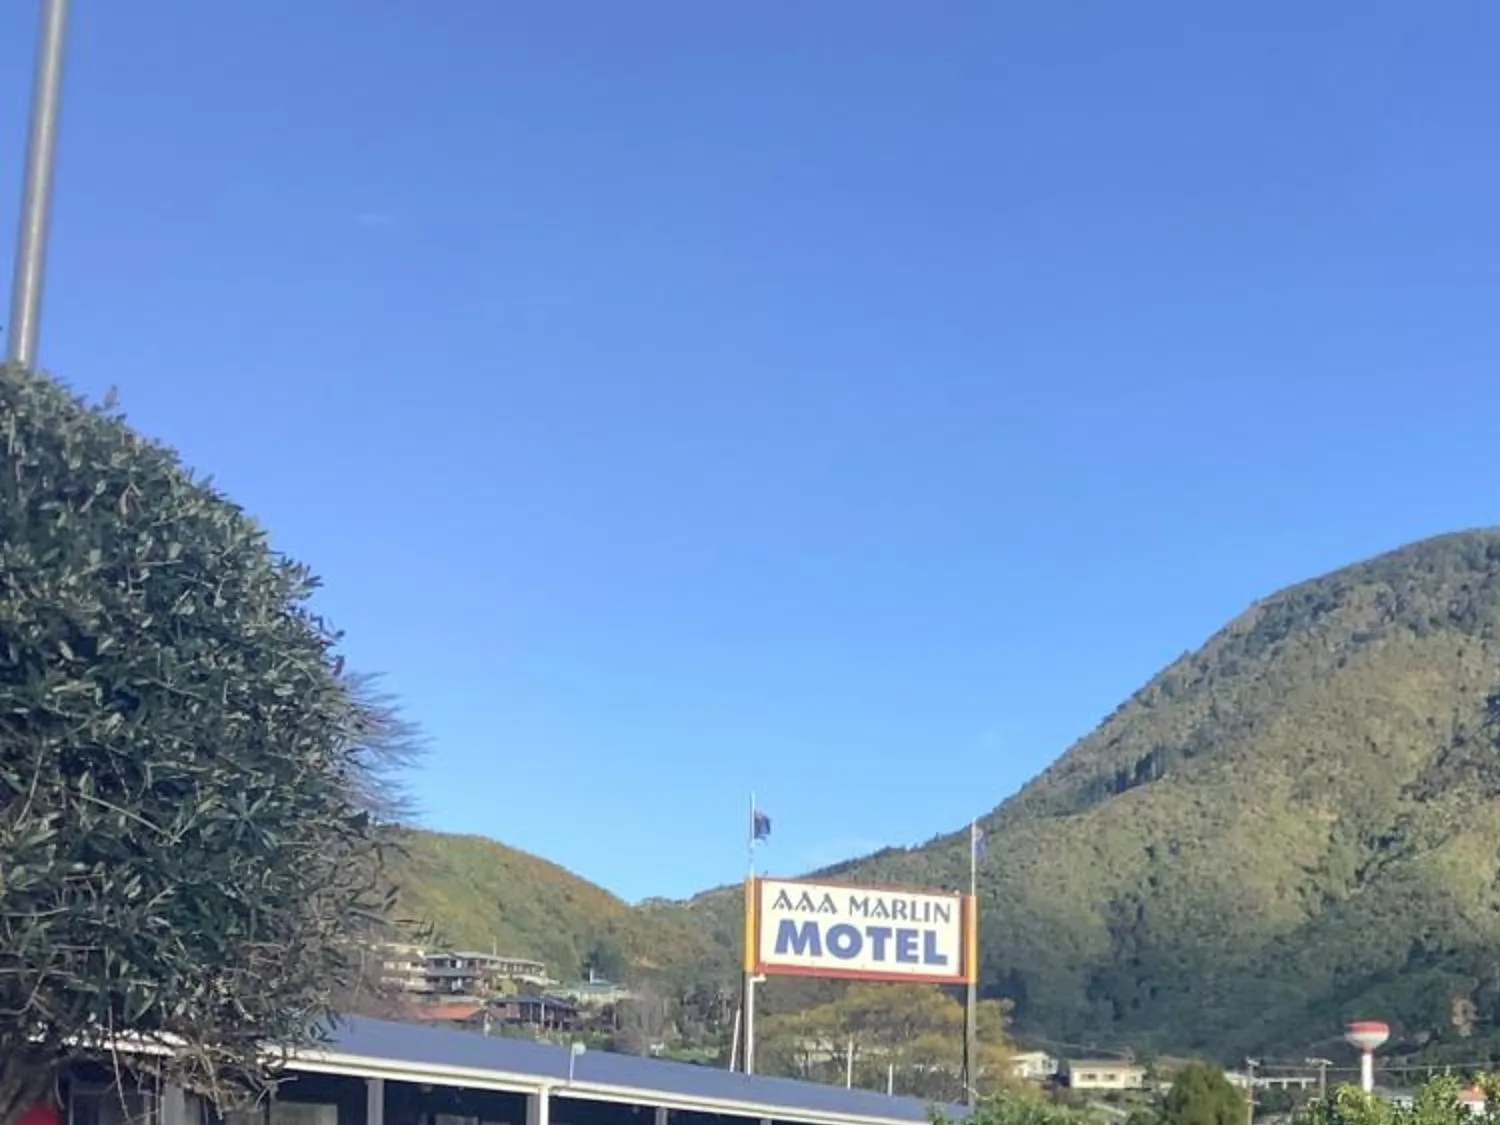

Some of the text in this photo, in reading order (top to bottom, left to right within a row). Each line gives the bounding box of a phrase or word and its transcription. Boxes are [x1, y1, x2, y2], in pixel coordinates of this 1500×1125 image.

[771, 889, 950, 924] AAA MARLIN
[774, 919, 948, 966] MOTEL
